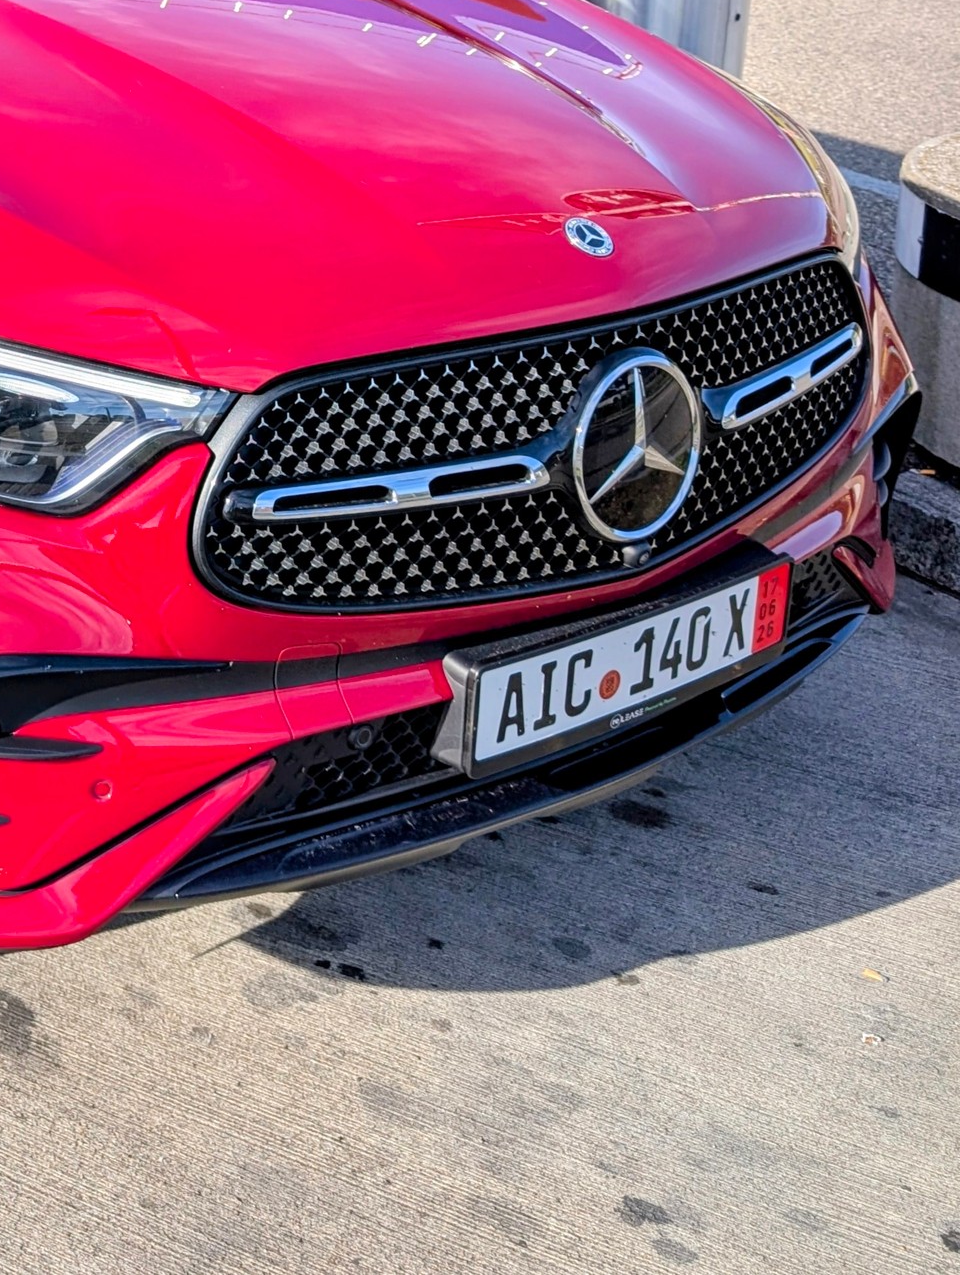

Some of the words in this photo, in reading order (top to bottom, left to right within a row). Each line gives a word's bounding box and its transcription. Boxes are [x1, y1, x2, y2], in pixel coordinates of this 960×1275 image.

[763, 576, 779, 599] 17
[759, 598, 776, 621] 06
[756, 620, 774, 643] 26
[496, 649, 594, 744] AIC
[629, 606, 712, 696] 140
[722, 588, 751, 658] X
